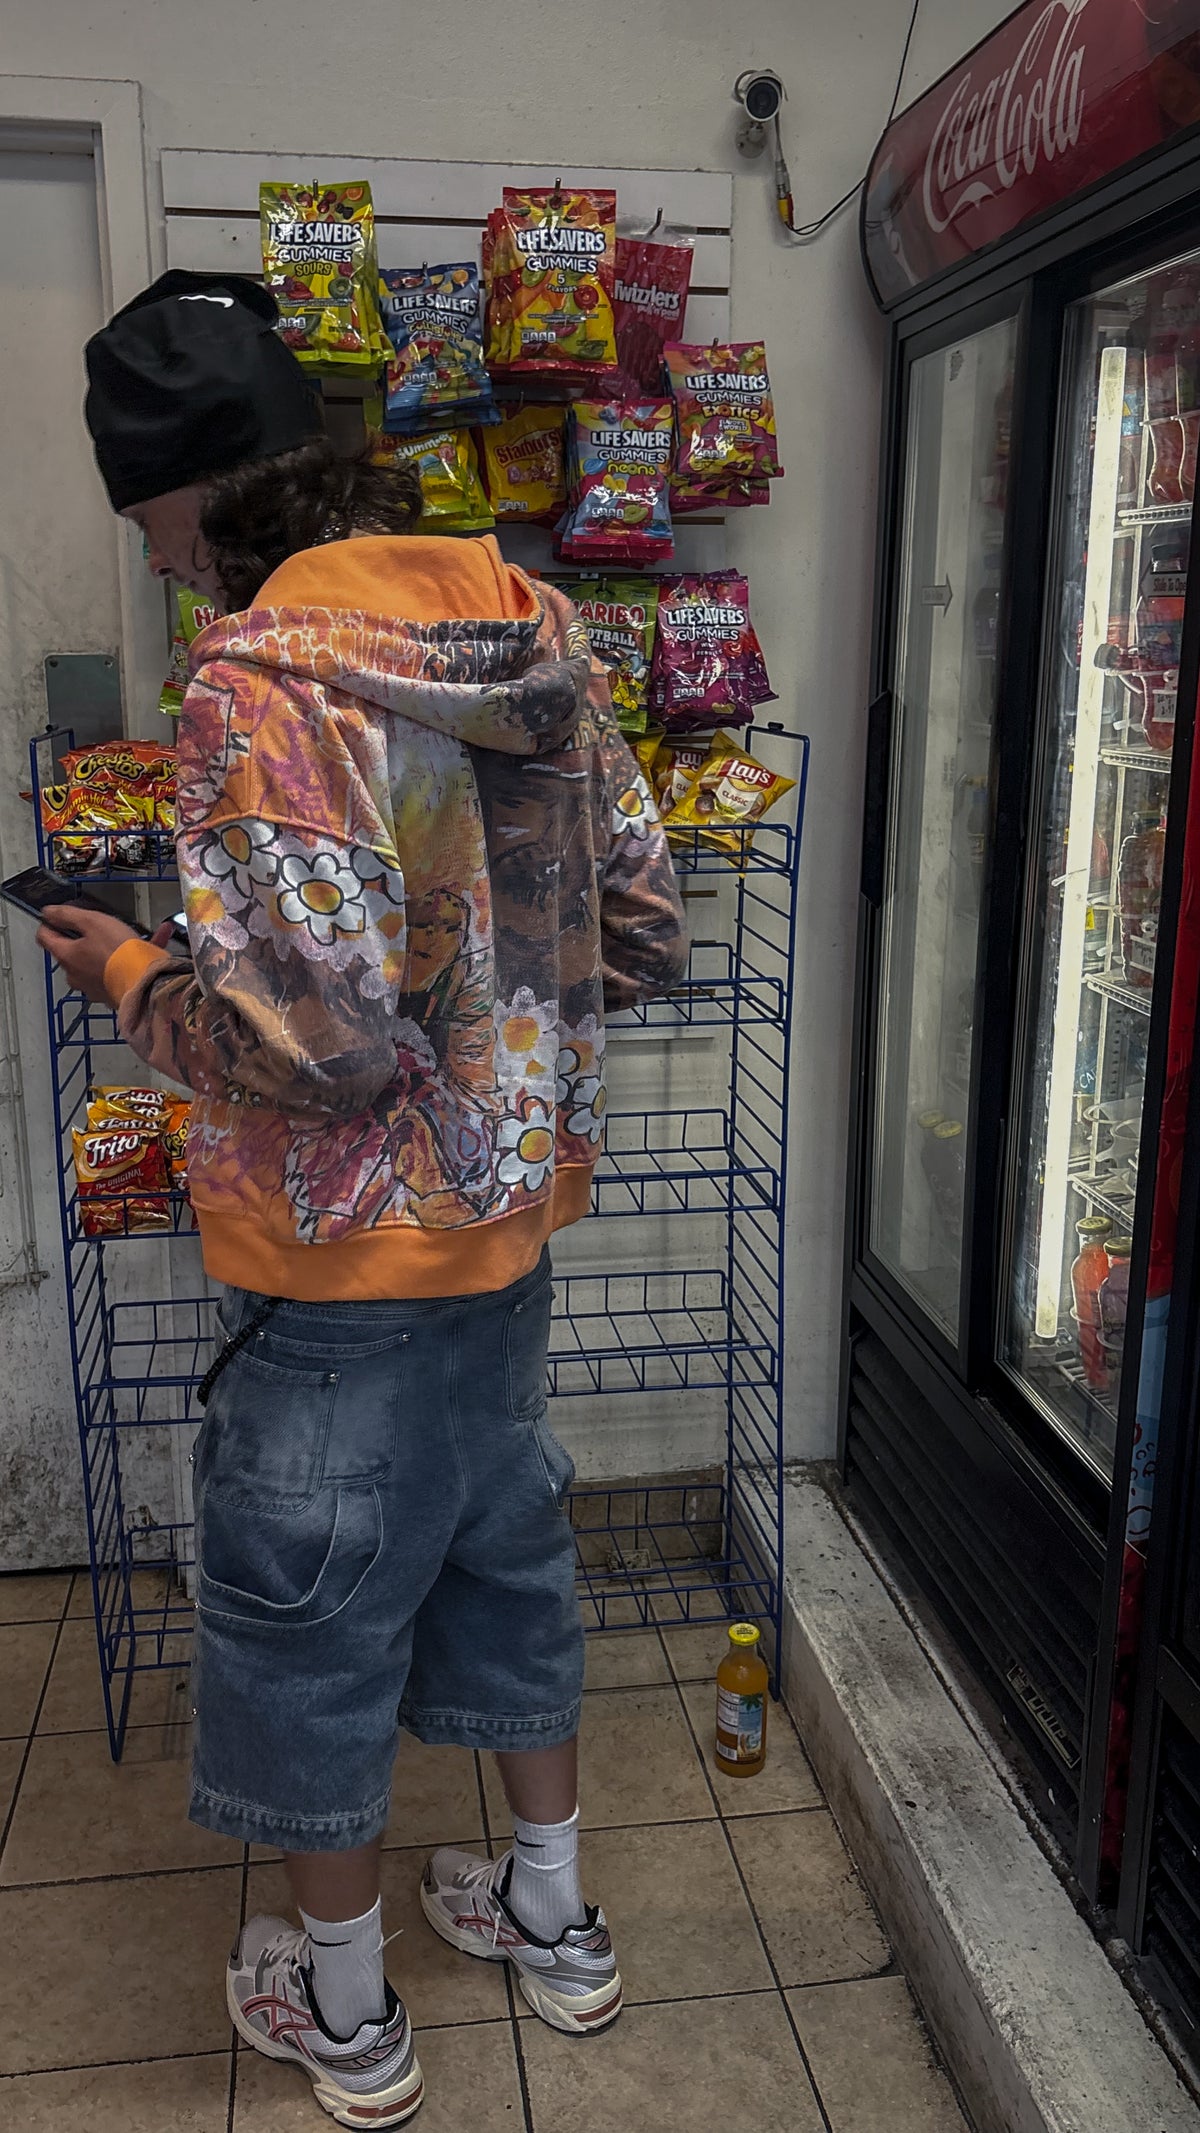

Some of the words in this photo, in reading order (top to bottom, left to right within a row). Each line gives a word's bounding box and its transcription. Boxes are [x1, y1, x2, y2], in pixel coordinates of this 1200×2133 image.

[270, 223, 304, 243] LIFE
[305, 223, 360, 243] SAVERS
[549, 229, 606, 252] SAVERS
[279, 247, 352, 262] GUMMIES
[295, 263, 332, 275] SOURS
[527, 257, 598, 274] GUMMIES
[557, 274, 565, 284] 5
[547, 284, 578, 293] FLAVORS
[614, 279, 680, 309] Twizzlers
[394, 294, 425, 311] LIFE
[425, 294, 477, 315] SAVERS
[403, 311, 467, 333] GUMMIES
[686, 374, 717, 389] LIFE
[716, 373, 767, 391] SAVERS
[696, 392, 761, 405] GUMMIES
[702, 404, 760, 420] EXOTICS
[592, 431, 622, 447] LIFE
[622, 430, 671, 448] SAVERS
[599, 450, 666, 463] GUMMIES
[607, 463, 656, 475] neons
[667, 609, 695, 625] LIFE
[695, 607, 746, 625] SAVERS
[587, 628, 636, 647] OTBALL
[677, 630, 739, 641] GUMMIES
[592, 640, 610, 649] MIX
[726, 760, 770, 784] Lay's
[722, 790, 749, 807] CLASSIC
[107, 1169, 144, 1186] ORIGINAL
